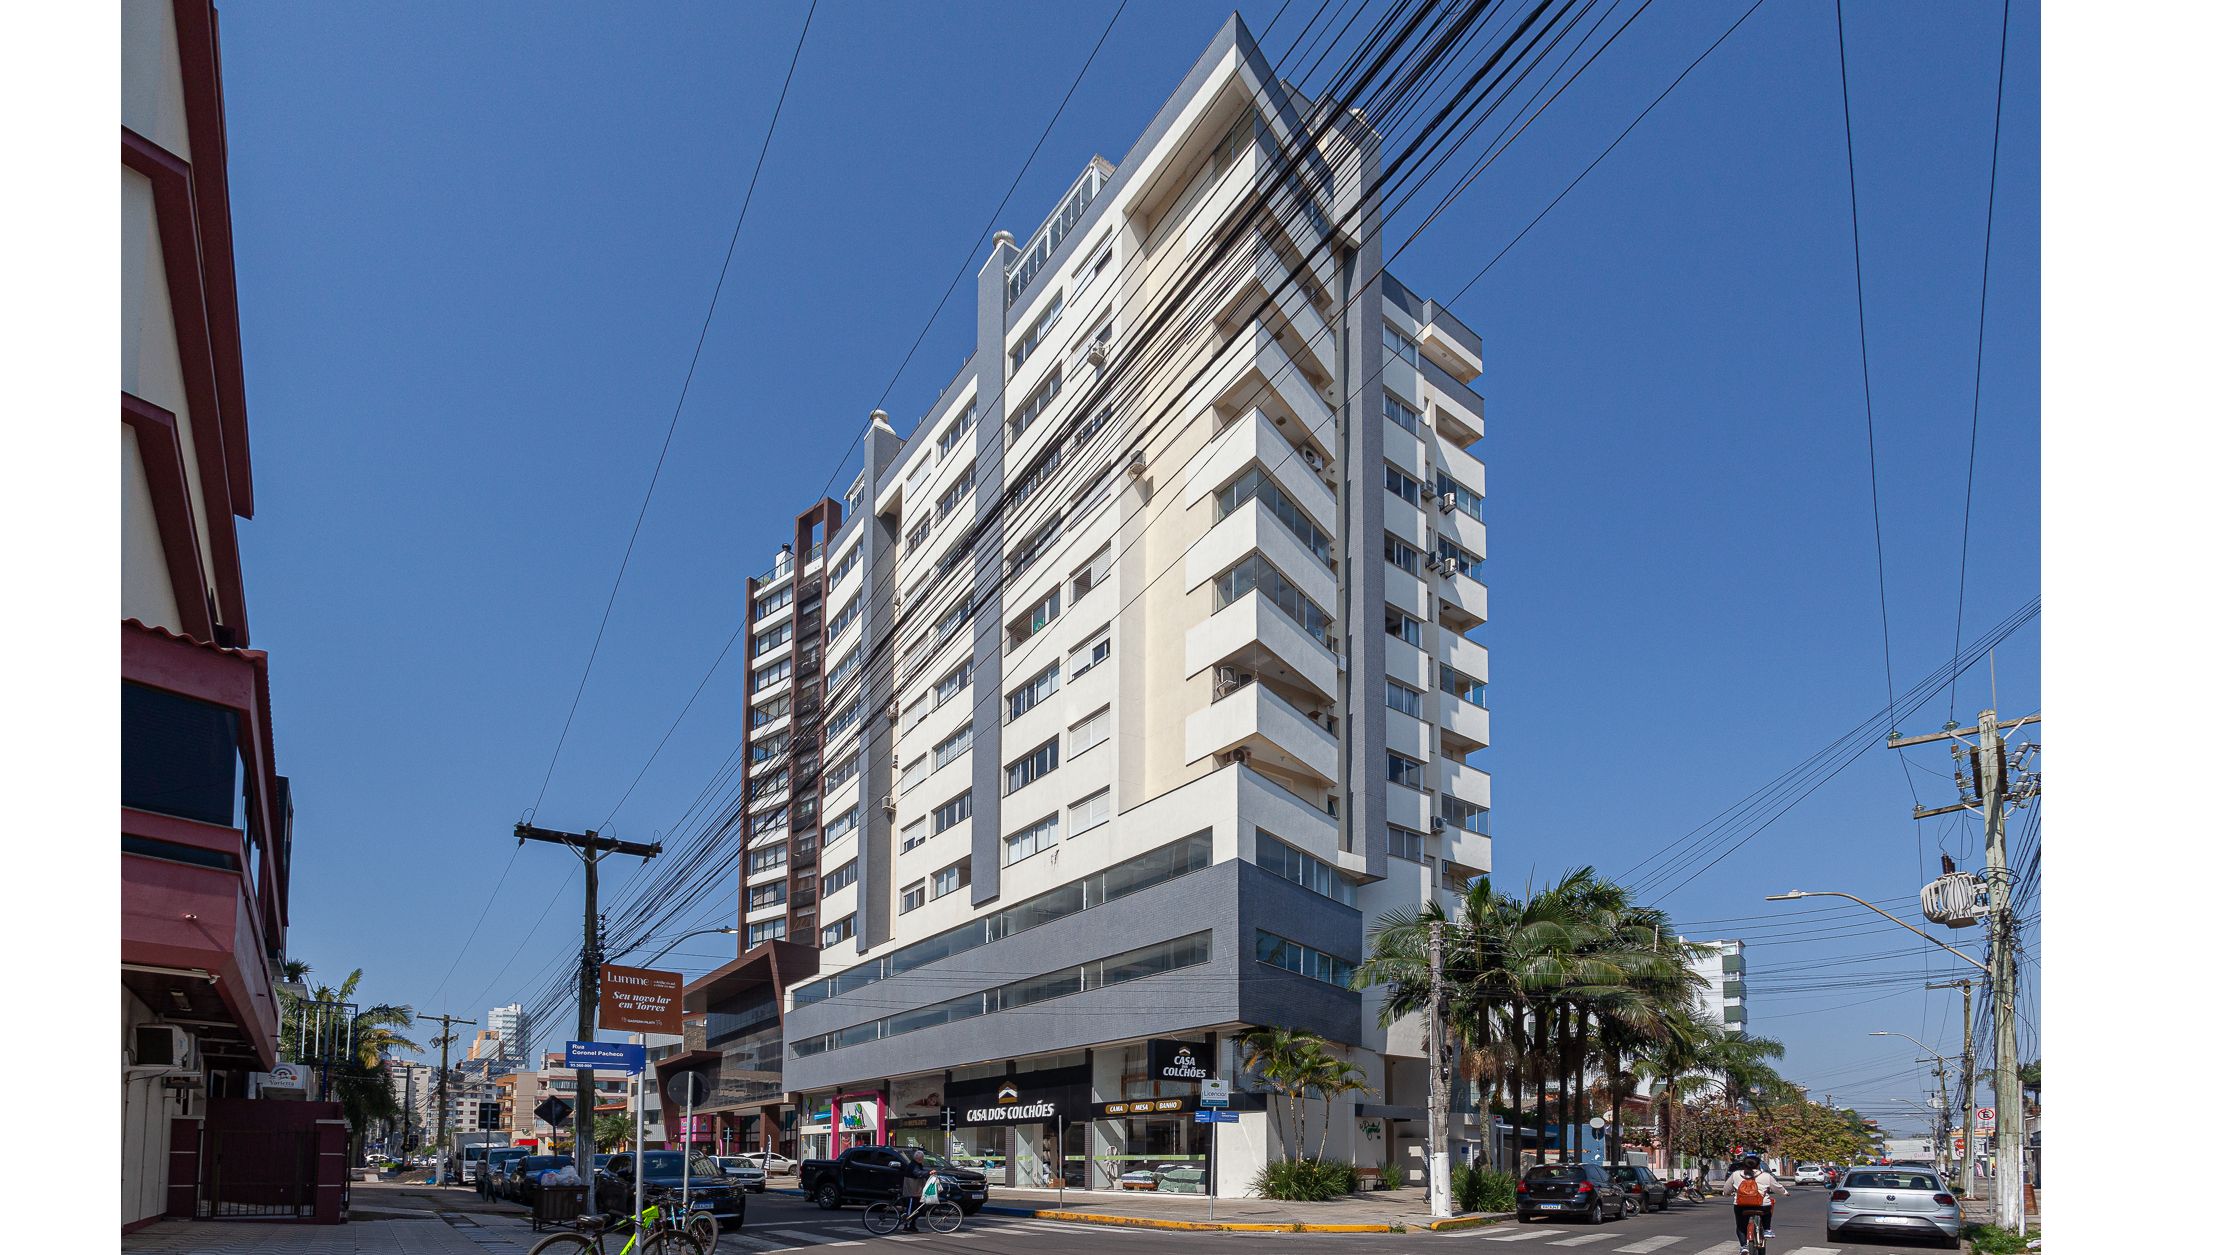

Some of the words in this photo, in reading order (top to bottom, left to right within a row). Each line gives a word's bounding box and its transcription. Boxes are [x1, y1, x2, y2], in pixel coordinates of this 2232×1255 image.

[612, 991, 631, 1001] Seu
[632, 994, 656, 1003] novo
[656, 995, 672, 1005] lar
[618, 1001, 633, 1009] em
[635, 1002, 666, 1012] Torres
[1173, 1056, 1196, 1066] CASA
[1162, 1066, 1207, 1078] COLCHÕES
[966, 1108, 988, 1122] CASA
[987, 1106, 1007, 1120] DOS
[1006, 1099, 1055, 1120] COLCHÕES
[1109, 1105, 1124, 1113] CAMA
[1134, 1103, 1149, 1111] MESA
[1159, 1101, 1177, 1109] BANHO
